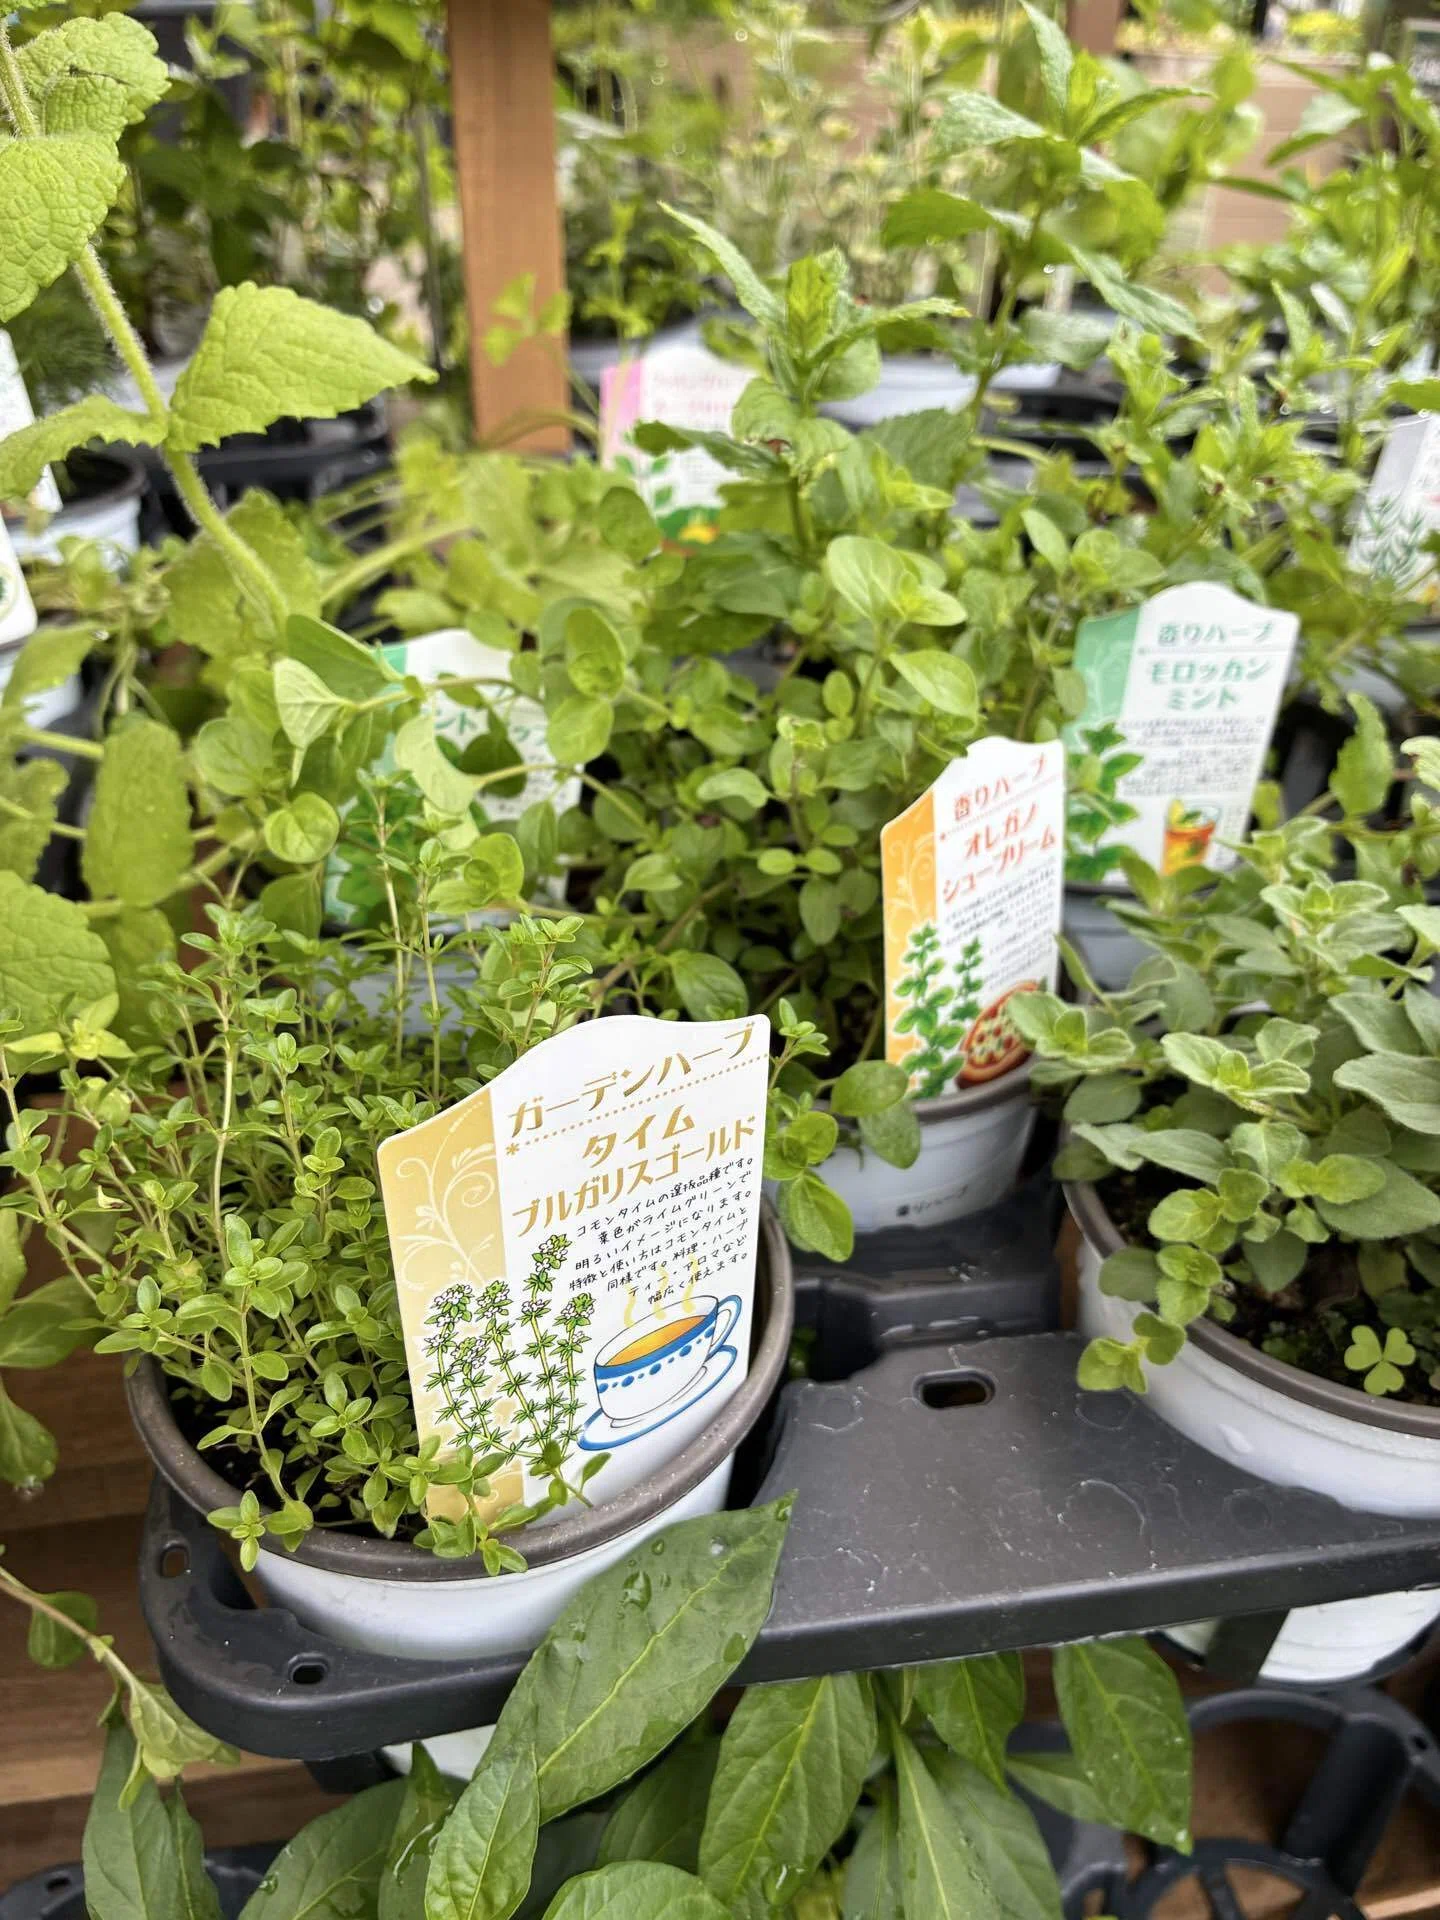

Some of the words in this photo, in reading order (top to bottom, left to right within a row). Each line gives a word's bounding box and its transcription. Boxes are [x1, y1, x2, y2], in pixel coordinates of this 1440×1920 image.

[1149, 658, 1270, 684] モロッカン
[1166, 687, 1238, 711] ミント
[966, 803, 1038, 859] オレガノ
[508, 1022, 755, 1138] ガーデンハーブ
[582, 1104, 695, 1168] タイム
[512, 1116, 756, 1237] ブルガリスゴールド
